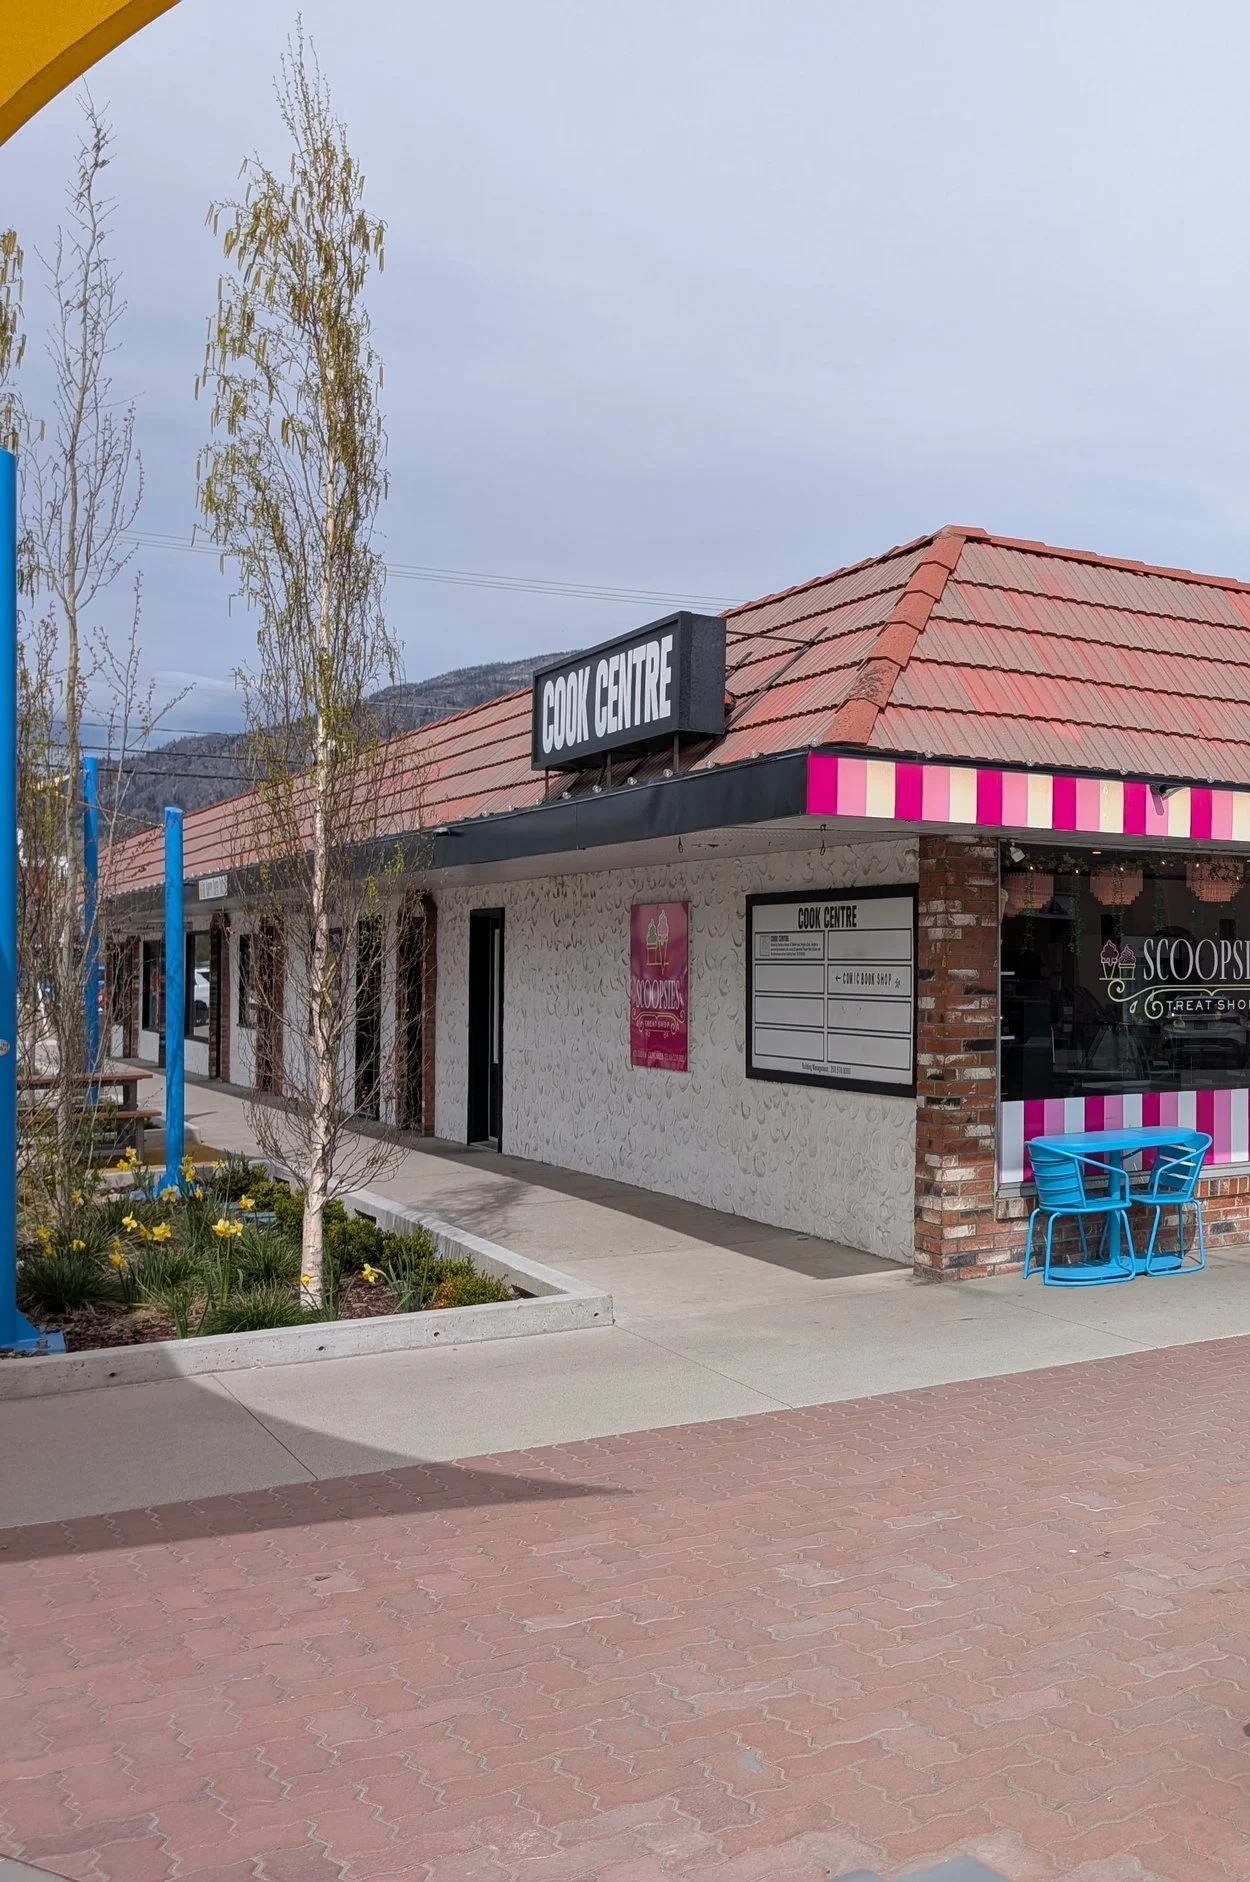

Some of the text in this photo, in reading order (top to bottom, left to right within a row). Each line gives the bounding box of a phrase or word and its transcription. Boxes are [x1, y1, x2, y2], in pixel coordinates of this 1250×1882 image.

[542, 634, 673, 754] COOK CENTRE
[798, 905, 857, 929] COOK CENTRE
[843, 973, 892, 986] COMIC BOOK SHOP
[636, 979, 680, 1010] SCOOPSIES
[1166, 1000, 1212, 1011] TREAT
